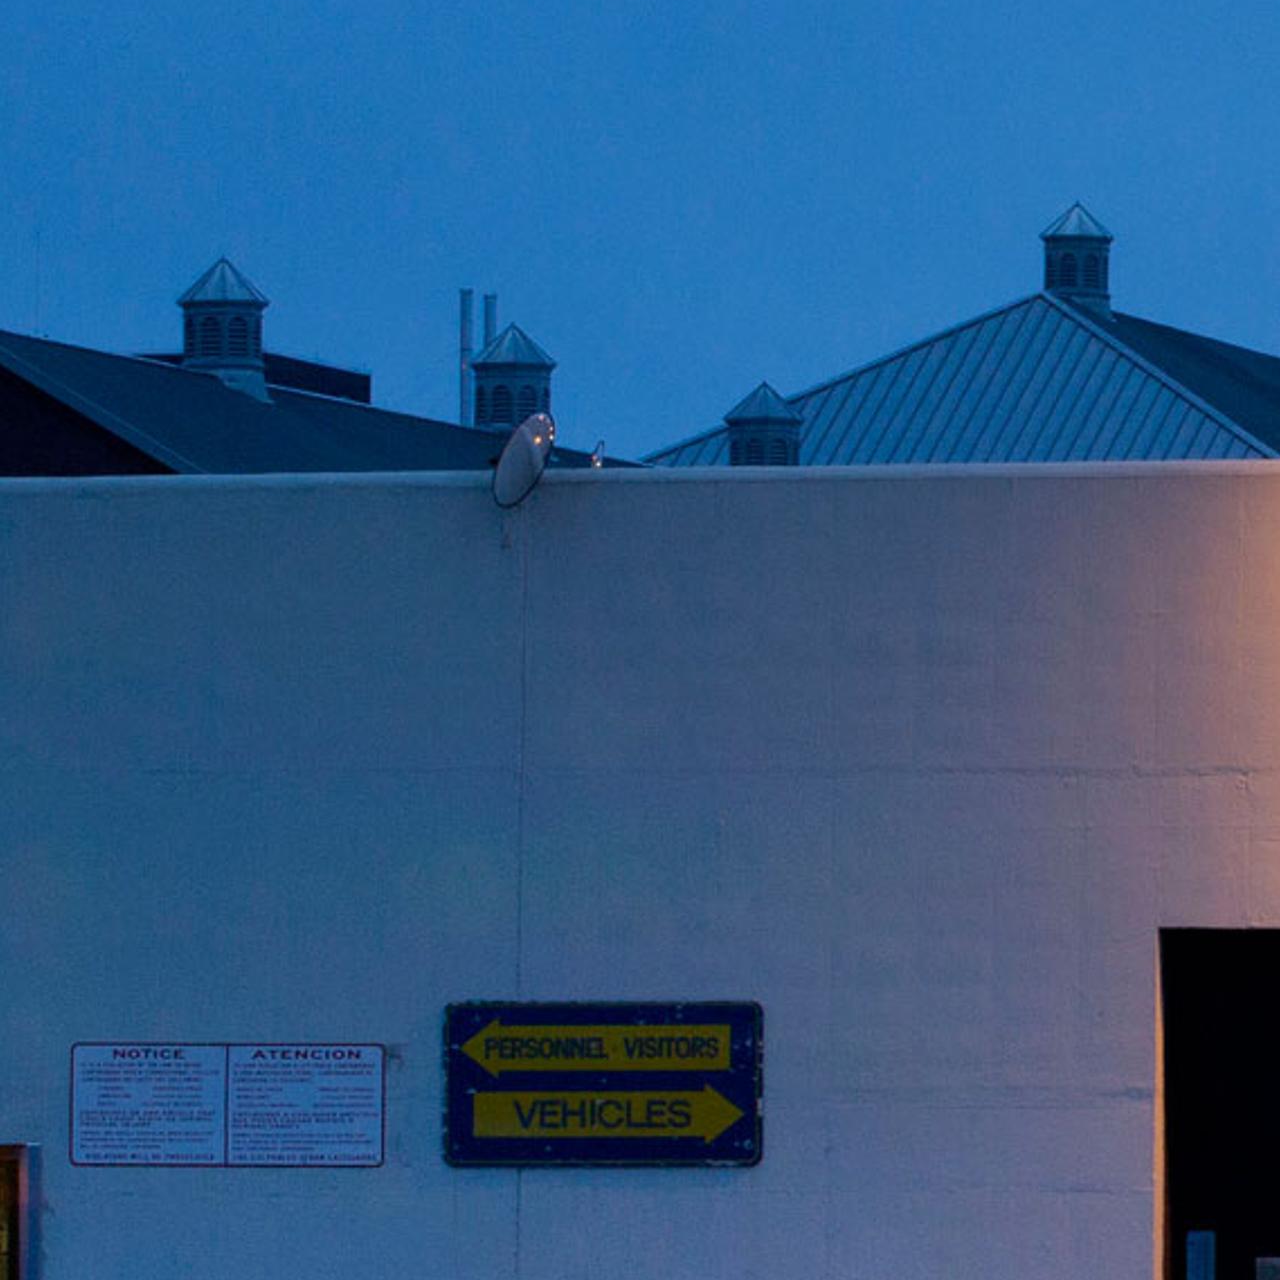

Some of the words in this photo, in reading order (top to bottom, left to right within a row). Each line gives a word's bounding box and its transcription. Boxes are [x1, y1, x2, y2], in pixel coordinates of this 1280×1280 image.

[112, 1048, 186, 1061] NOTICE
[251, 1048, 362, 1061] ATENCION
[484, 1036, 608, 1060] PERSONNEL
[623, 1035, 719, 1059] VISITORS
[513, 1099, 692, 1129] VEHICLES
